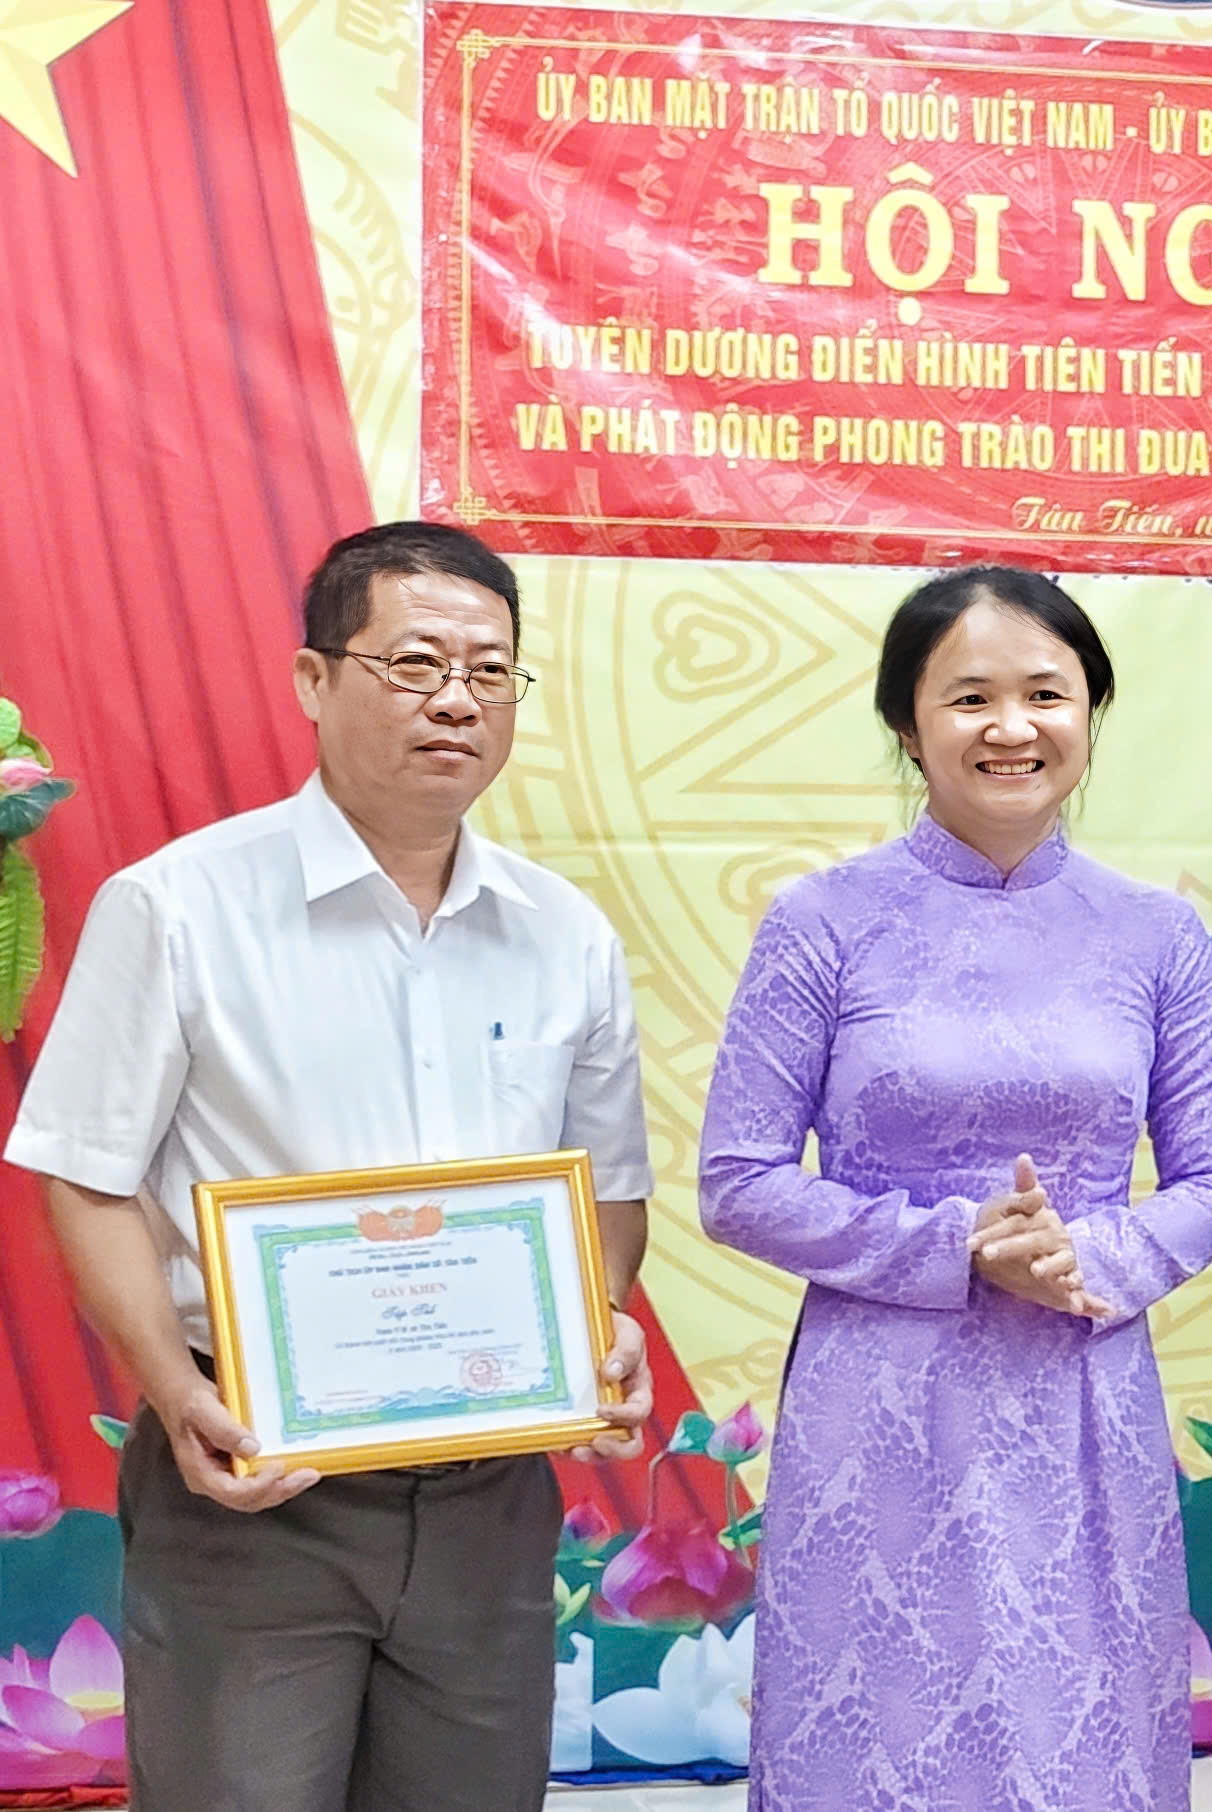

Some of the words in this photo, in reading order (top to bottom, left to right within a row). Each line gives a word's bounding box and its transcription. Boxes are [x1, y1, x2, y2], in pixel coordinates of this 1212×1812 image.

[536, 56, 577, 122] ỦY
[588, 74, 653, 125] BAN
[664, 74, 731, 139] MẶT
[742, 78, 820, 143] TRẬN
[833, 71, 869, 137] TỔ
[881, 77, 959, 145] QUỐC
[971, 89, 1035, 156] VIỆT
[1046, 101, 1115, 151] NAM
[1125, 126, 1138, 138] -
[1148, 92, 1186, 155] ỦY
[757, 161, 1010, 326] HỘI
[526, 316, 651, 376] TUYÊN
[664, 327, 800, 382] DƯƠNG
[810, 318, 902, 386] ĐIỂN
[915, 332, 1010, 389] HÌNH
[1021, 336, 1107, 394] TIÊN
[1118, 336, 1202, 398] TIẾN
[515, 394, 567, 451] VÀ
[580, 399, 681, 456] PHÁT
[692, 402, 801, 469] ĐỘNG
[812, 414, 945, 468] PHONG
[957, 414, 1055, 472] TRÀO
[1067, 426, 1126, 474] THI
[1138, 428, 1210, 478] ĐUA
[1011, 496, 1084, 534] Tân
[1099, 498, 1182, 538] Tiến,
